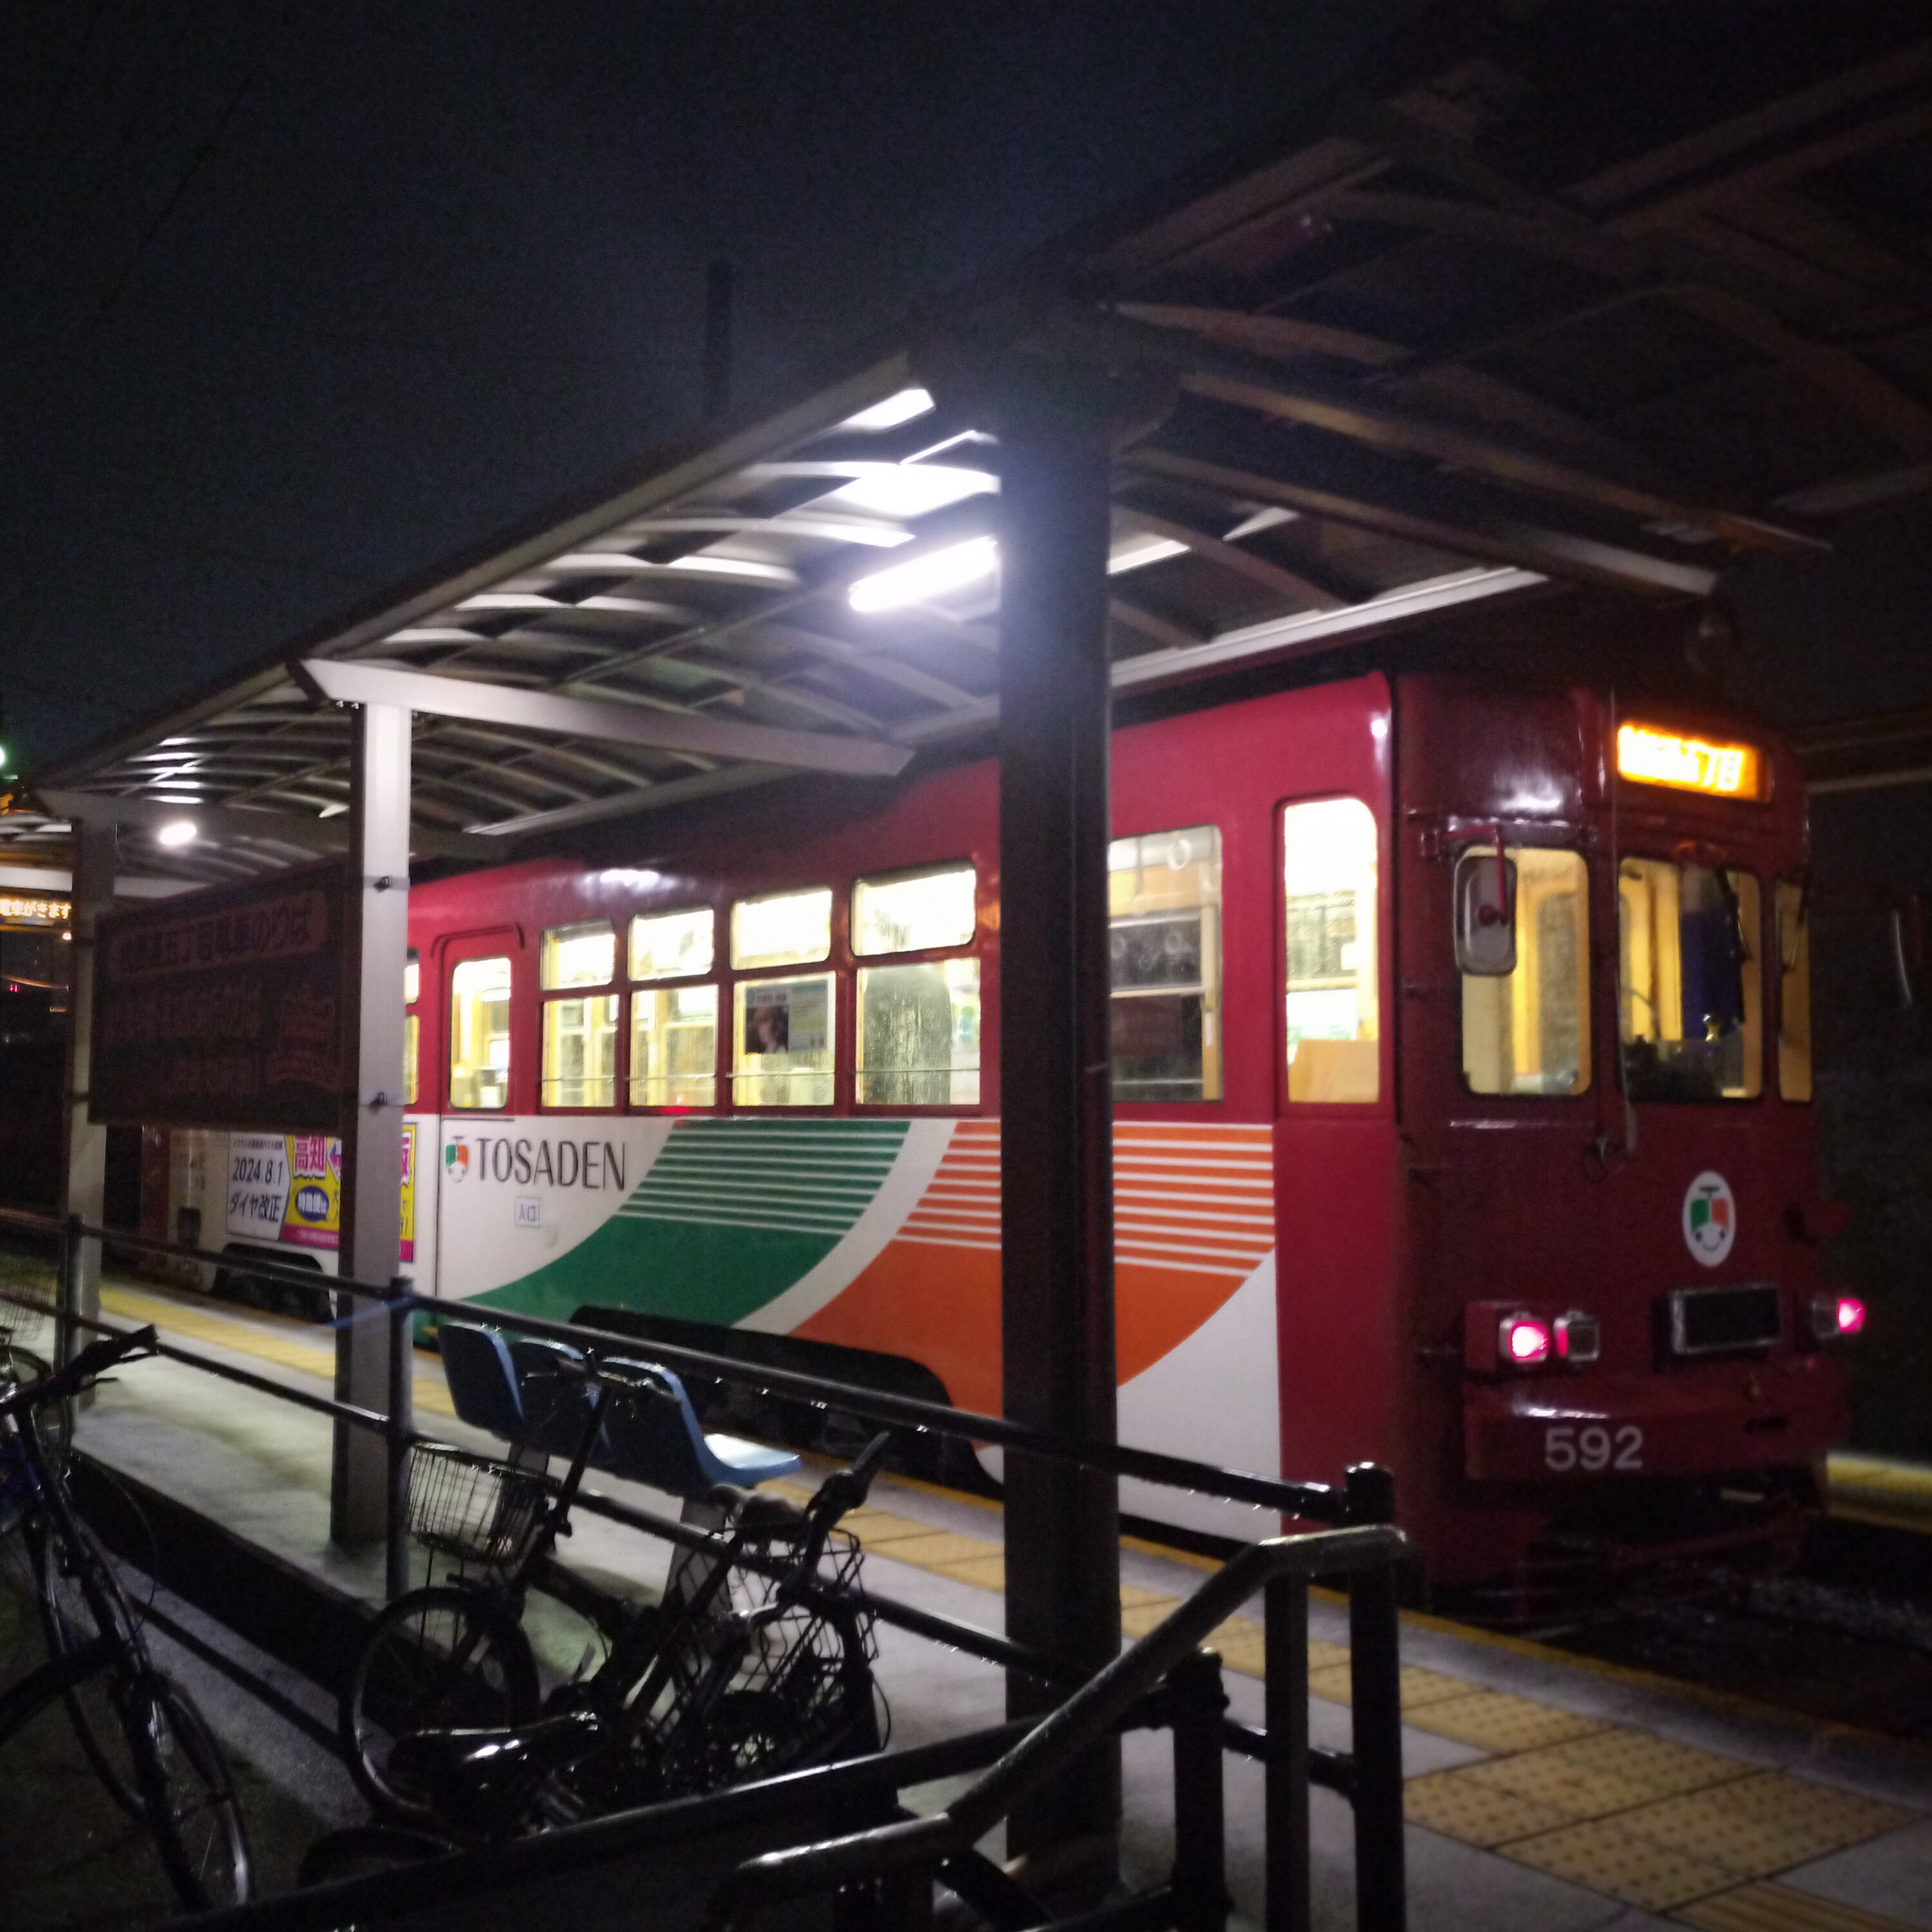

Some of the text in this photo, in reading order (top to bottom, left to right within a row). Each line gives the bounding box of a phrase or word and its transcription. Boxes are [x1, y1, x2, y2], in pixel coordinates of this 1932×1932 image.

[232, 1157, 283, 1186] 2024.8.1
[477, 1137, 625, 1191] TOSADEN
[229, 1191, 282, 1222] ダイヤ改正
[1545, 1425, 1643, 1472] 592
